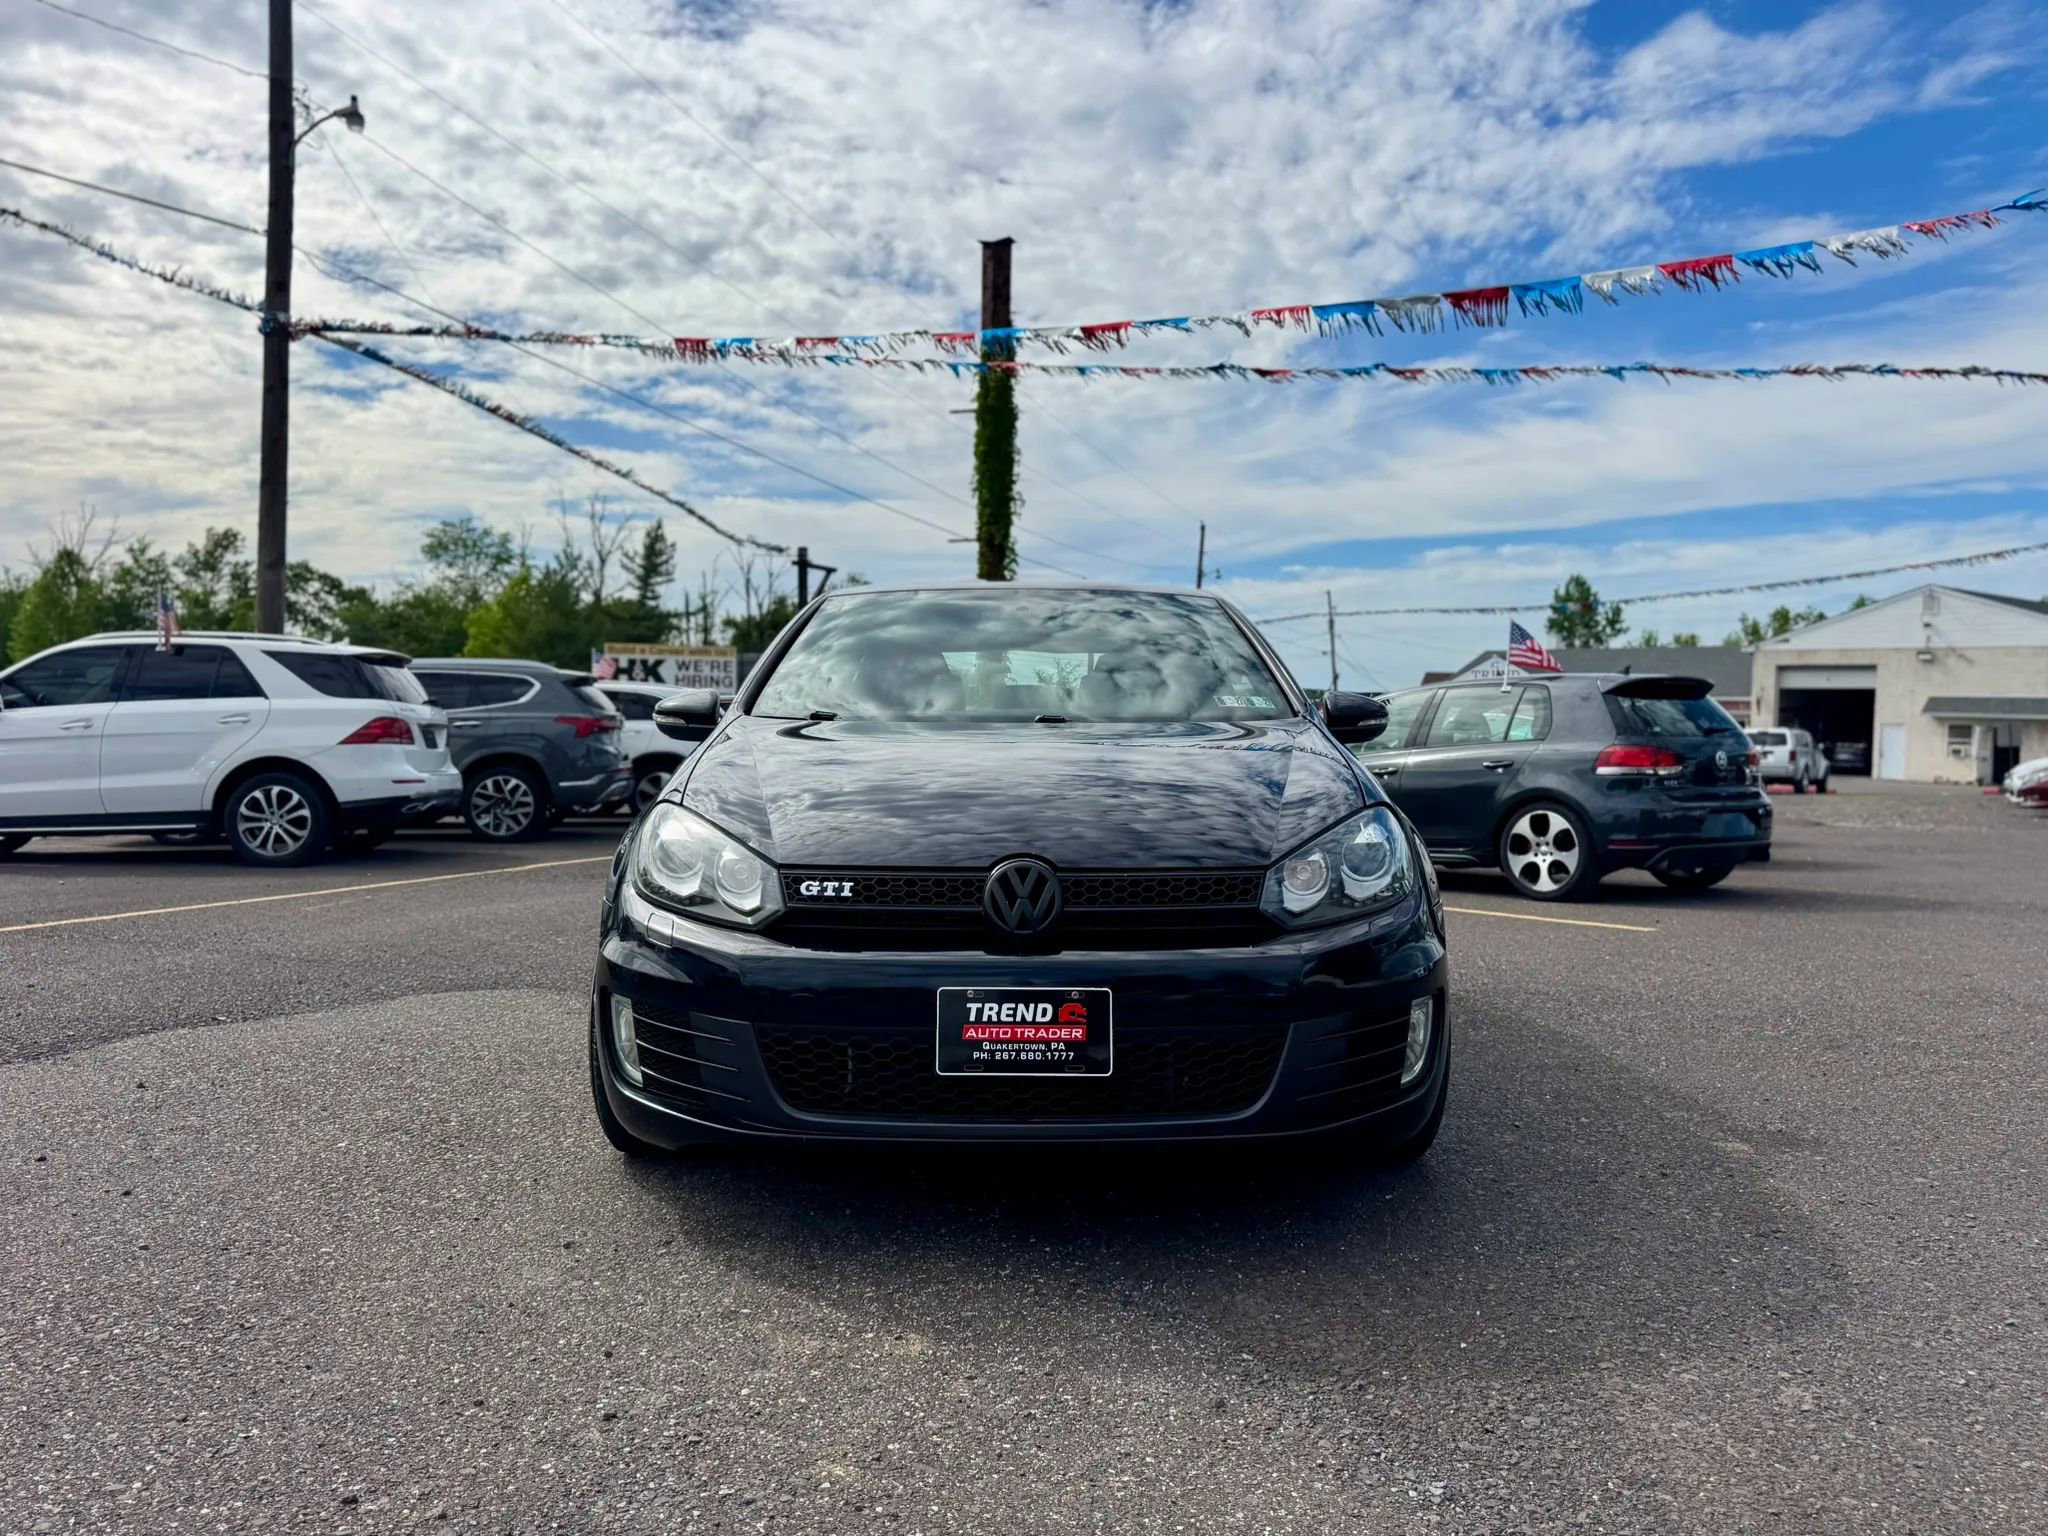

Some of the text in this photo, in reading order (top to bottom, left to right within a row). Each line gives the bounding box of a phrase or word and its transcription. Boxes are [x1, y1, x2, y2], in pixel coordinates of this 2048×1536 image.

[675, 659, 733, 673] WE'RE
[675, 674, 733, 688] HIRING
[800, 881, 854, 897] GTI
[966, 1002, 1053, 1022] TREND
[965, 1027, 1083, 1039] AUTO TRADER
[1051, 1042, 1066, 1050] PA
[973, 1051, 1074, 1060] PH: 267.680.1777
